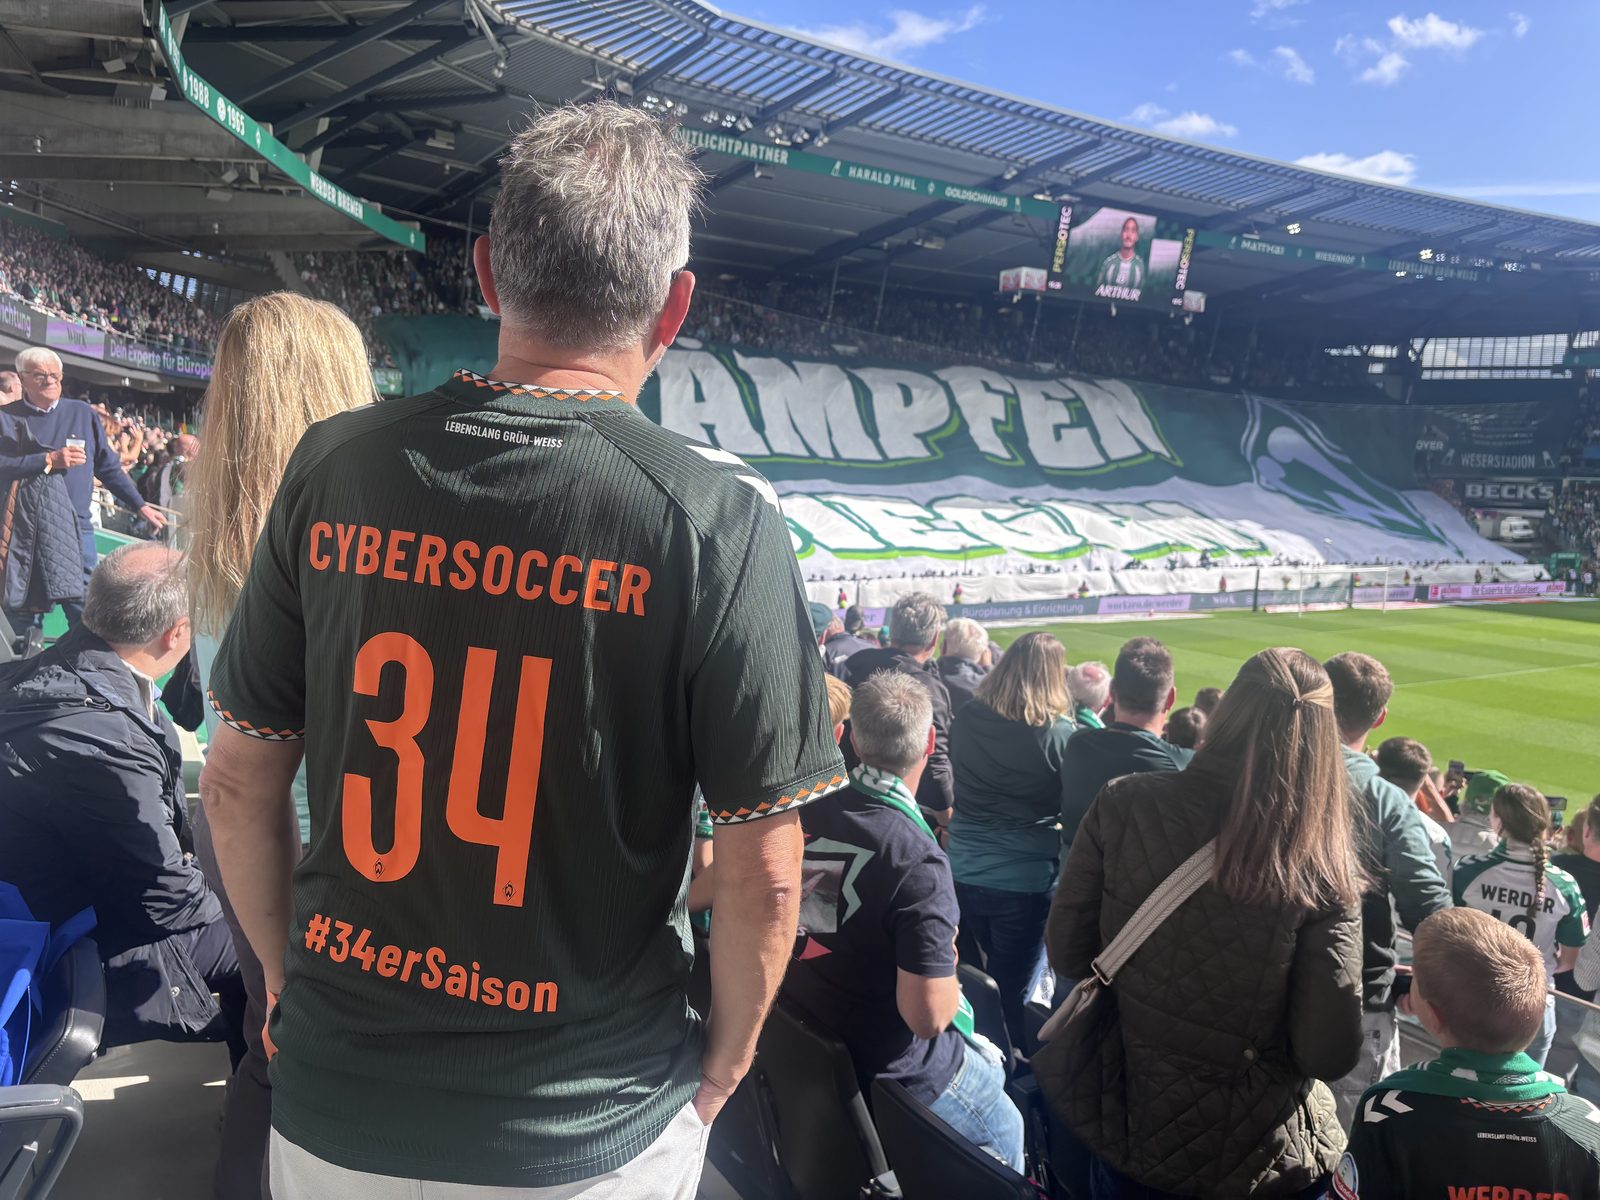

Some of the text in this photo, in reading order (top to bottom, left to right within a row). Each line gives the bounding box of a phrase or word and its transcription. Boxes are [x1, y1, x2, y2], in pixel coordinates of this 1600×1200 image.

[188, 73, 245, 136] 1988 1965
[848, 165, 917, 191] HARALD PIHL
[309, 169, 364, 221] WERDER BREMEN
[1094, 283, 1141, 301] ARTHUR
[0, 297, 31, 339] ichtung
[110, 339, 127, 359] Dein
[128, 346, 161, 369] Experte
[162, 352, 176, 370] für
[658, 336, 1176, 469] ÄMPFEN
[444, 420, 564, 449] LEBENSLANG GRÜN-WEISS
[1460, 452, 1535, 469] WESERSTADION
[1465, 482, 1554, 499] BECK'S
[308, 520, 652, 617] CYBERSOCCER
[961, 602, 1084, 618] Büroplanung & Einrichtung
[342, 631, 553, 908] 34
[1481, 883, 1555, 914] WERDR
[304, 912, 558, 1013] #34erSaison
